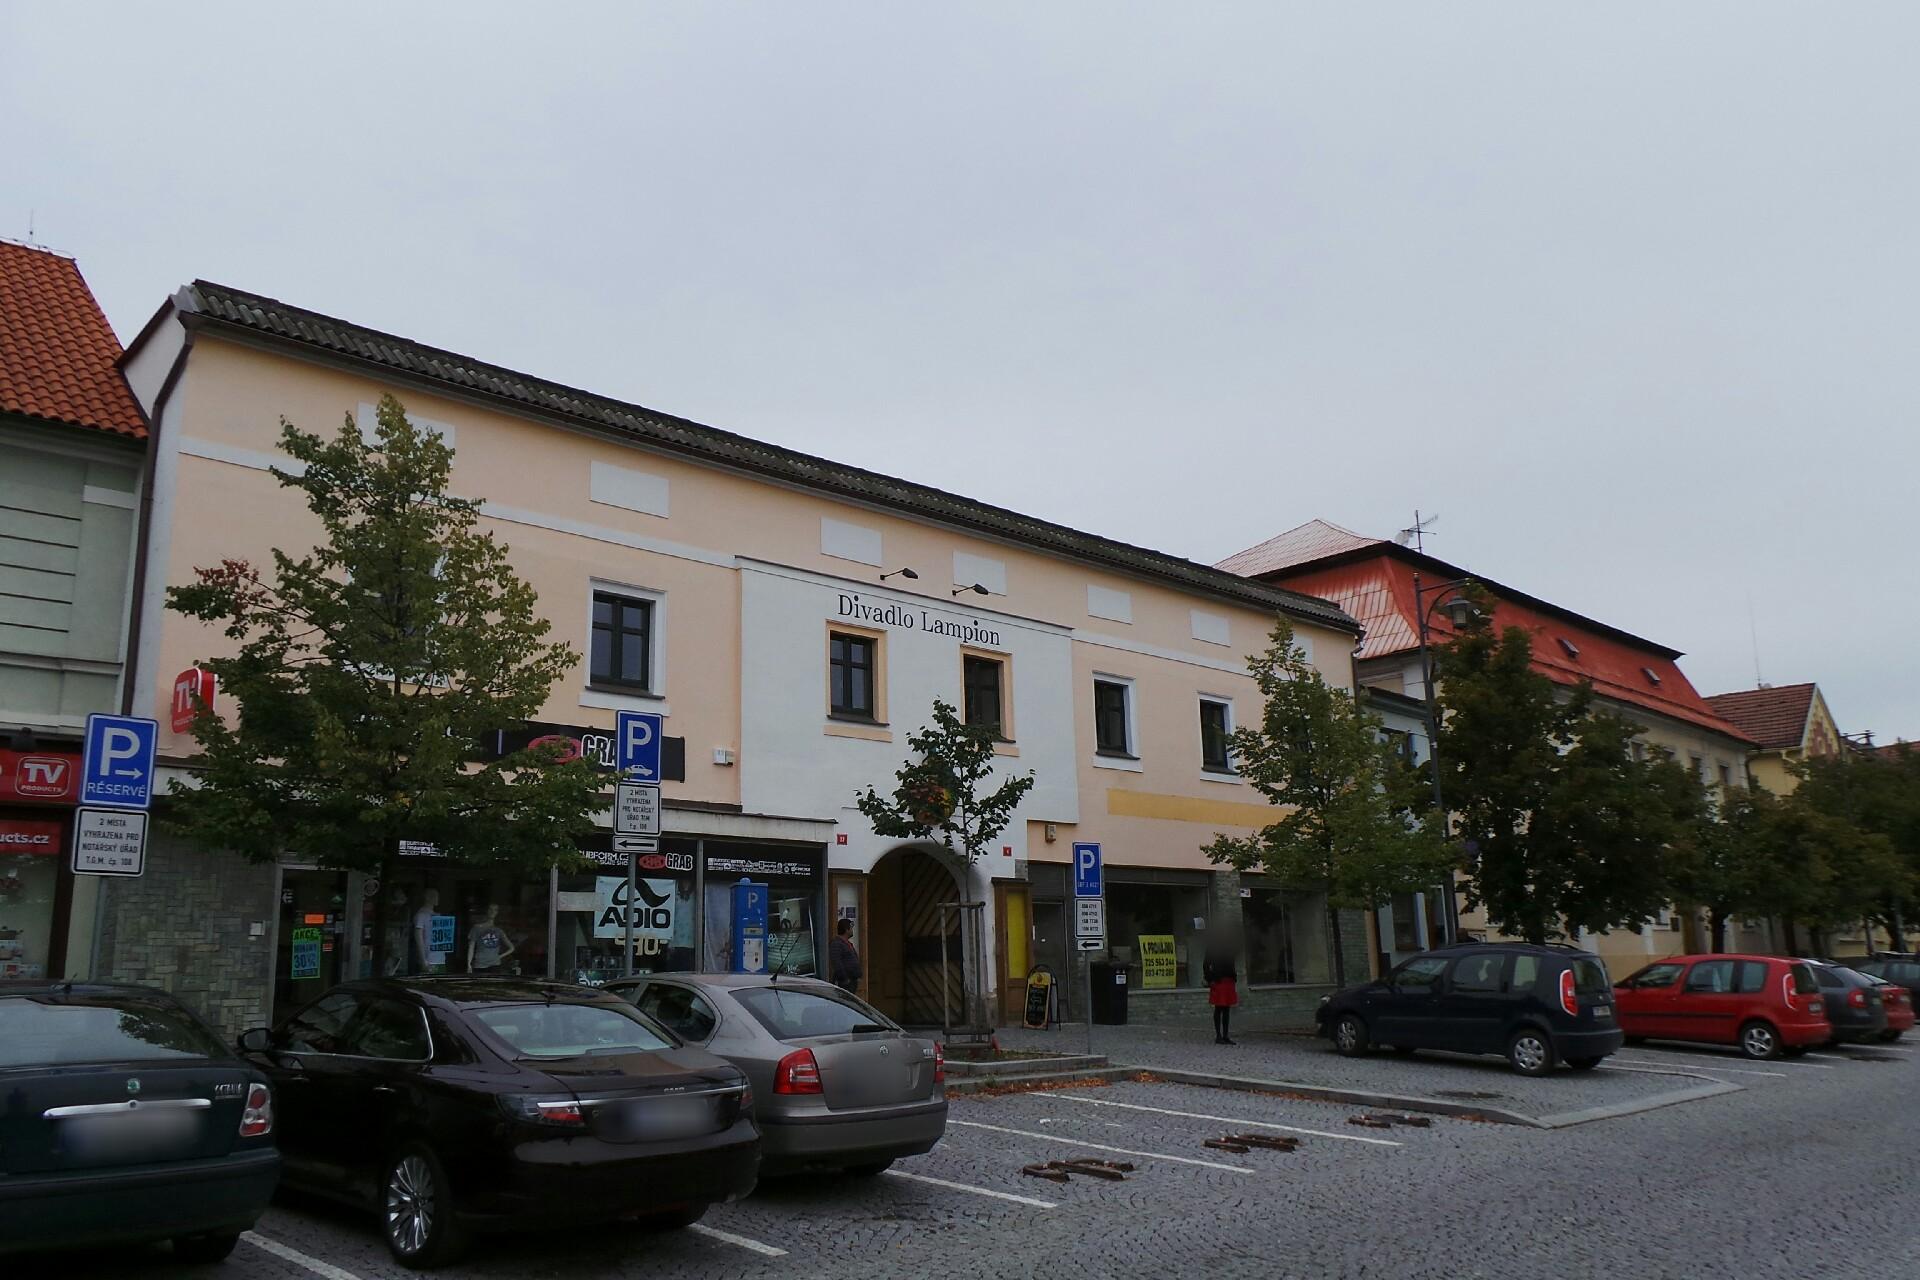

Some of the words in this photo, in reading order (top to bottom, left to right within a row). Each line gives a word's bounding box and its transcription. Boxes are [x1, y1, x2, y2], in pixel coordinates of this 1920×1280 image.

[838, 594, 914, 628] Divadlo
[920, 611, 1001, 646] Lampion
[626, 719, 652, 760] P
[99, 727, 141, 777] P
[23, 763, 65, 784] TV
[86, 781, 146, 798] RÉSERVÉ
[99, 818, 104, 826] 2
[83, 830, 123, 840] VYHRAZENA
[126, 832, 139, 841] PRO
[663, 854, 694, 871] GRAB
[1079, 849, 1096, 880] P
[748, 892, 759, 909] P
[598, 906, 671, 929] ADIO
